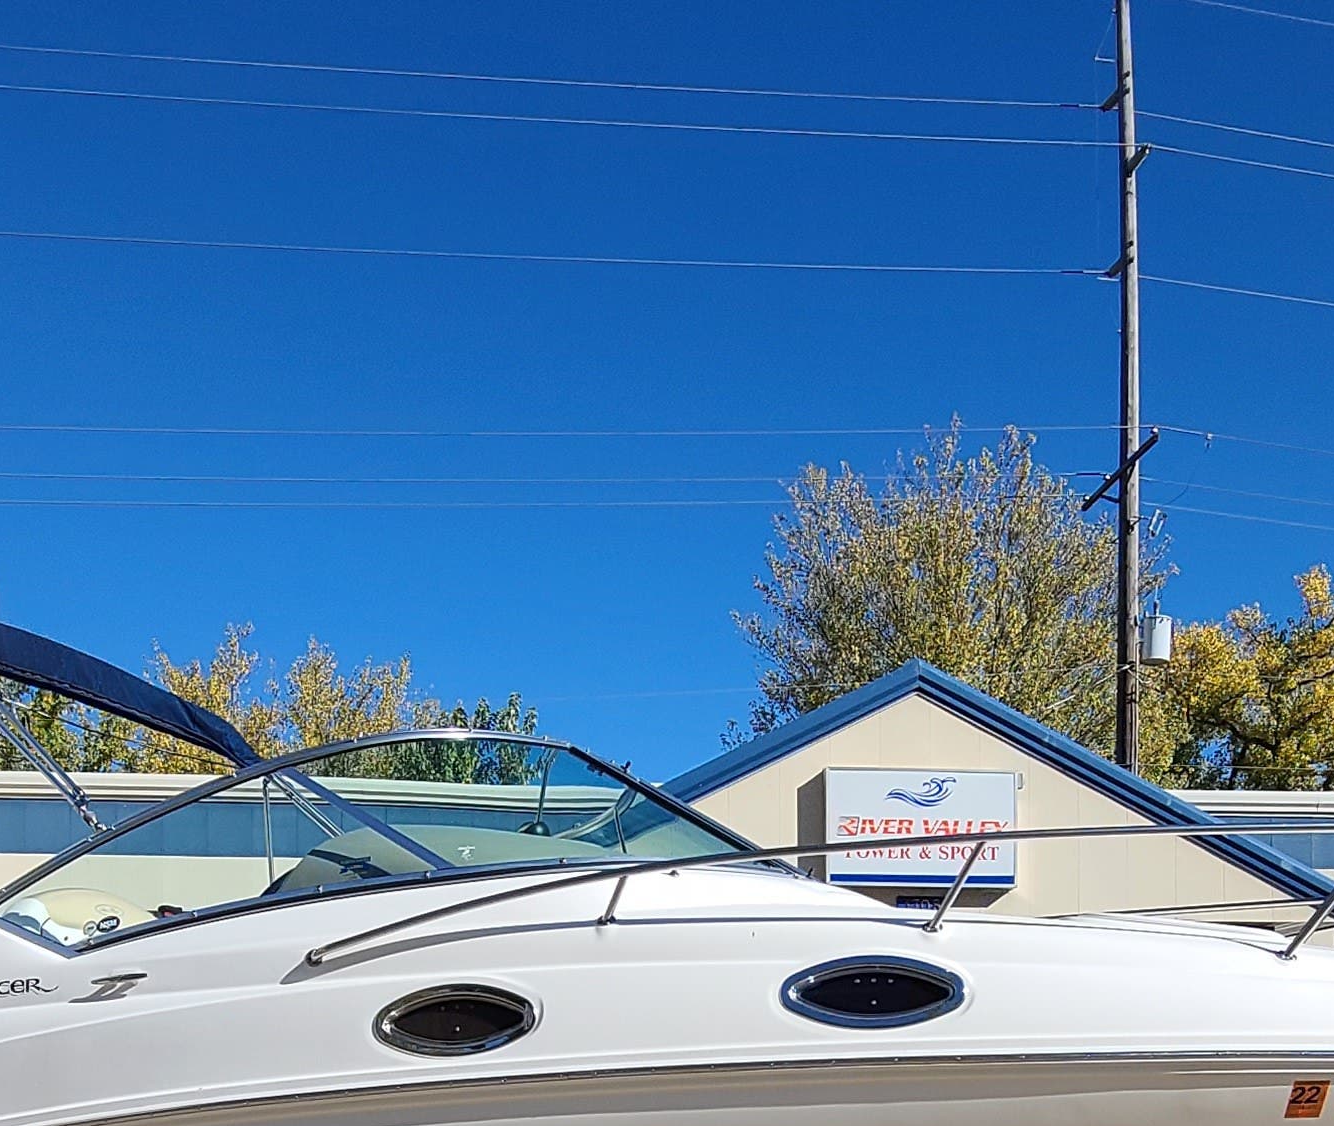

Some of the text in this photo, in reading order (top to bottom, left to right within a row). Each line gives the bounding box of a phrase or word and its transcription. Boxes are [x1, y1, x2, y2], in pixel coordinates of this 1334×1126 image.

[838, 816, 913, 836] RIVER
[919, 847, 931, 859] &
[1289, 1086, 1321, 1104] 22
